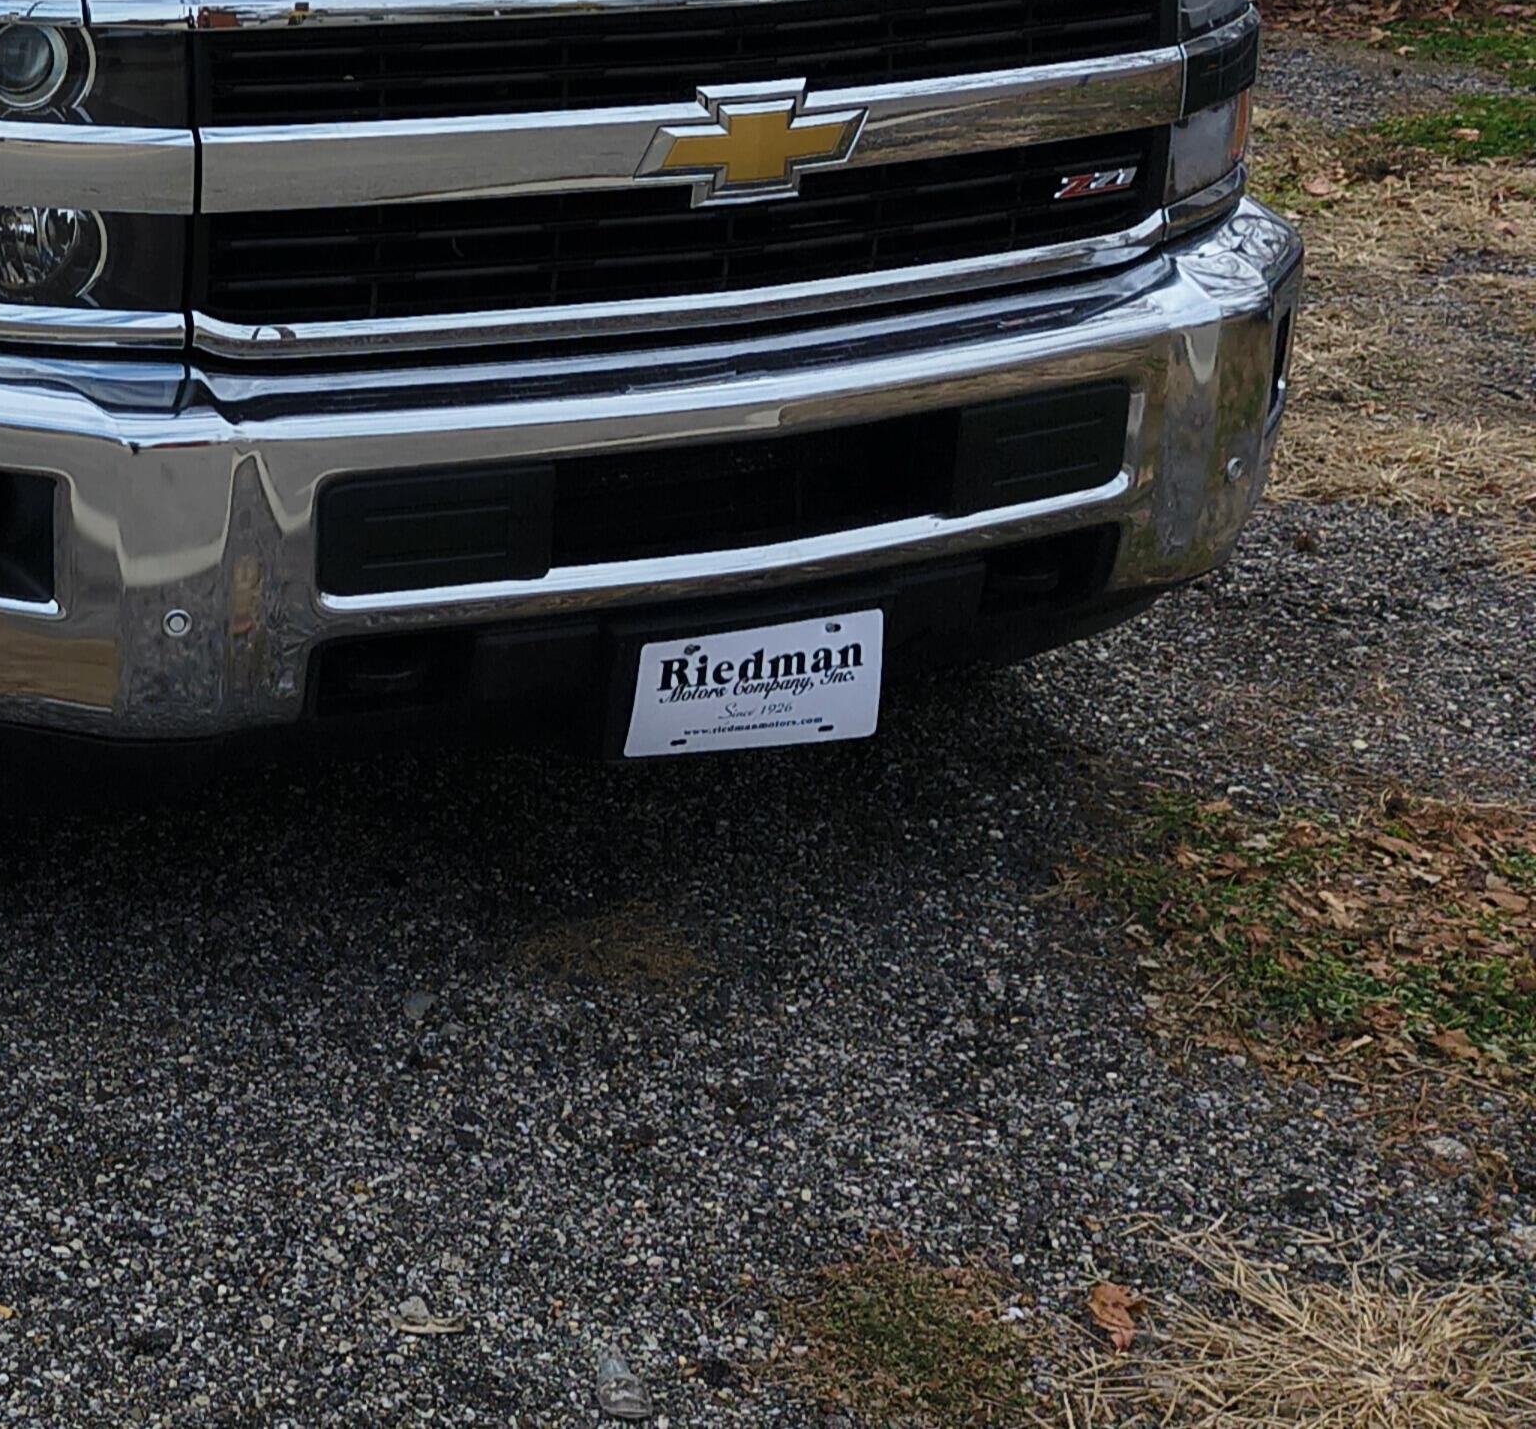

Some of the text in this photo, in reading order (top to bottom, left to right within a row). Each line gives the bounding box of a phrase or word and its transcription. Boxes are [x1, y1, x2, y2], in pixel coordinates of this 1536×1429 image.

[1054, 166, 1138, 199] Z71
[657, 642, 864, 692] Riedman
[658, 666, 855, 704] Motors Company, Inc.
[760, 702, 793, 715] 1926
[684, 717, 823, 736] www.riedmanmotors.com
